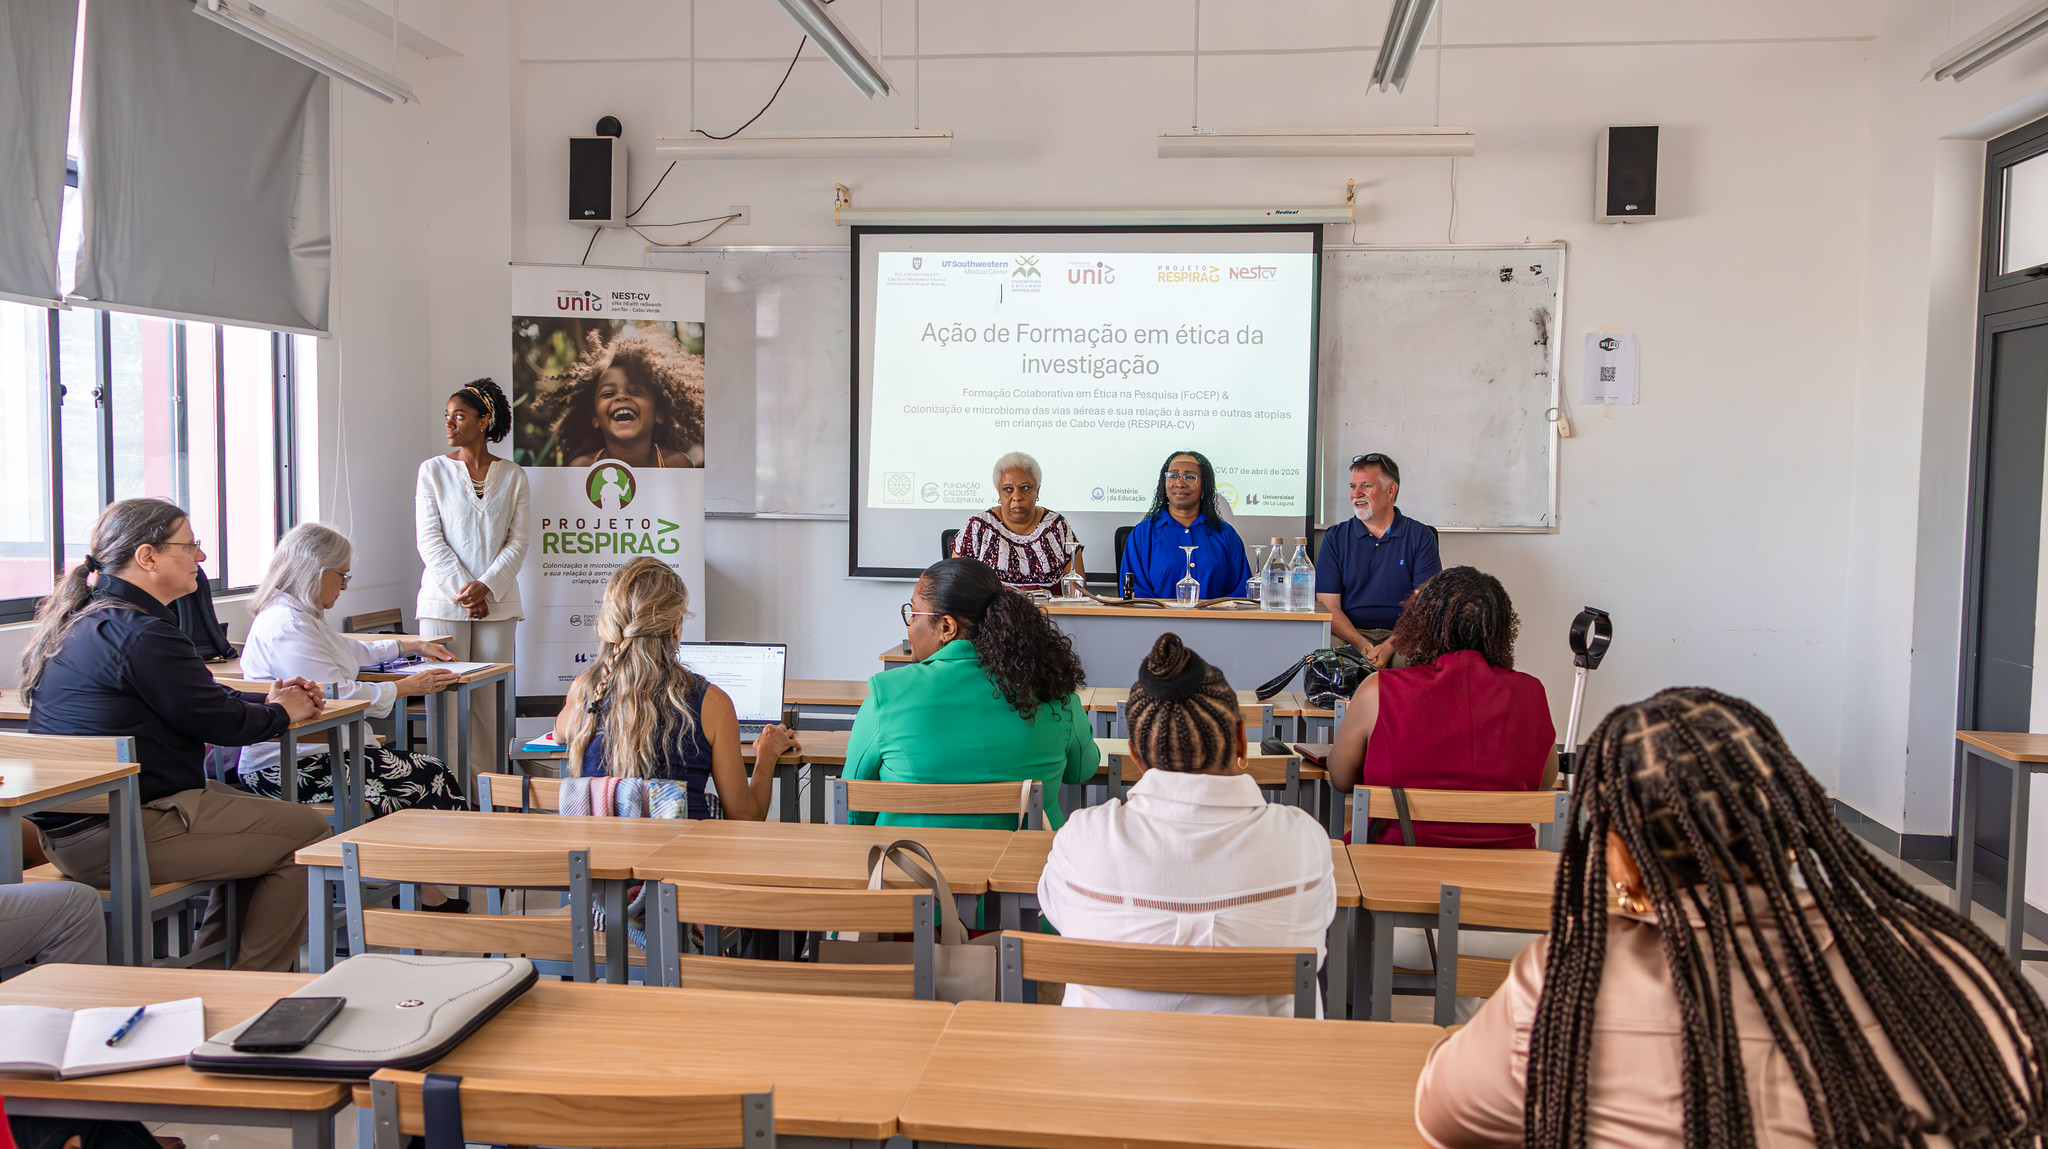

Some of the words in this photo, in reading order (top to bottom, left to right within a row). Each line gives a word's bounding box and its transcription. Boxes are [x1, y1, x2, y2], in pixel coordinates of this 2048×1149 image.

[1158, 272, 1208, 282] RESPIRA
[611, 292, 651, 301] NEST-CV
[921, 322, 977, 347] Ação
[983, 323, 1010, 343] de
[1017, 323, 1128, 349] Formação
[1133, 329, 1169, 345] em
[1175, 325, 1230, 345] ética
[1236, 325, 1264, 345] da
[1021, 353, 1160, 379] investigação
[962, 388, 1011, 400] Formação
[1012, 388, 1074, 398] Colaborativa
[1093, 387, 1118, 399] Ética
[1119, 391, 1132, 399] na
[1134, 389, 1179, 401] Pesquisa
[1180, 390, 1220, 402] (FoCEP)
[1221, 391, 1230, 400] &
[903, 404, 963, 415] Colonização
[964, 406, 971, 414] e
[972, 405, 1030, 415] microbioma
[1032, 406, 1050, 415] das
[1051, 406, 1071, 415] vias
[1073, 407, 1106, 416] aéreas
[1107, 408, 1114, 416] e
[1115, 408, 1134, 416] sua
[1135, 407, 1173, 419] relação
[1174, 407, 1181, 417] à
[1182, 409, 1210, 417] asma
[1211, 409, 1218, 417] e
[1220, 409, 1252, 418] outras
[1254, 410, 1292, 420] atopias
[994, 420, 1010, 428] em
[1012, 419, 1053, 430] crianças
[1055, 419, 1068, 428] de
[1069, 419, 1096, 428] Cabo
[1097, 420, 1126, 428] Verde
[1127, 420, 1195, 431] (RESPIRA-CV)
[1214, 466, 1228, 474] CV,
[943, 482, 981, 491] FUNDAÇÃO
[542, 518, 651, 530] PROJETO
[542, 532, 656, 554] RESPIRA
[542, 562, 583, 570] Colonização
[562, 570, 587, 578] relação
